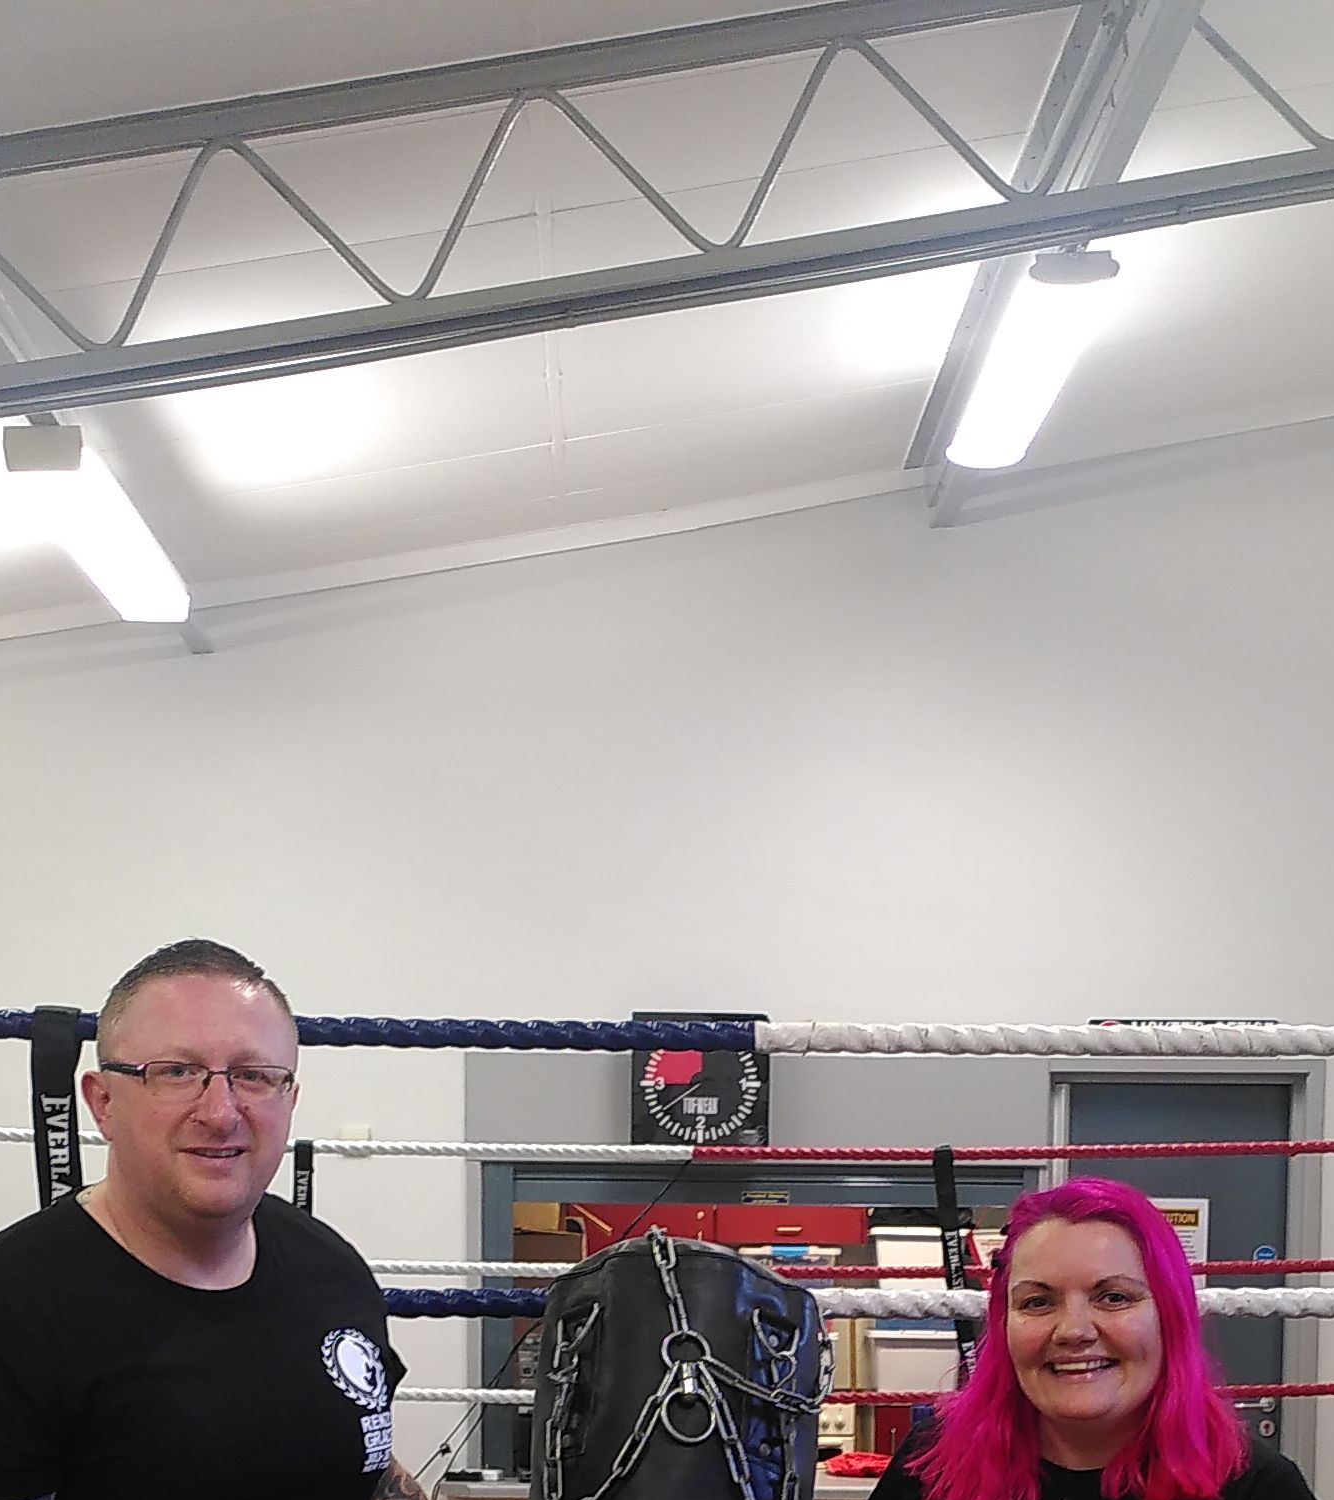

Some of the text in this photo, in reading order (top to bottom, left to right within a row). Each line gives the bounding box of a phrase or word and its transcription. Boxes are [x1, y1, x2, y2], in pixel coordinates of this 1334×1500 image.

[654, 1076, 666, 1091] 3
[694, 1115, 707, 1130] 2
[40, 1092, 72, 1206] EVERLA
